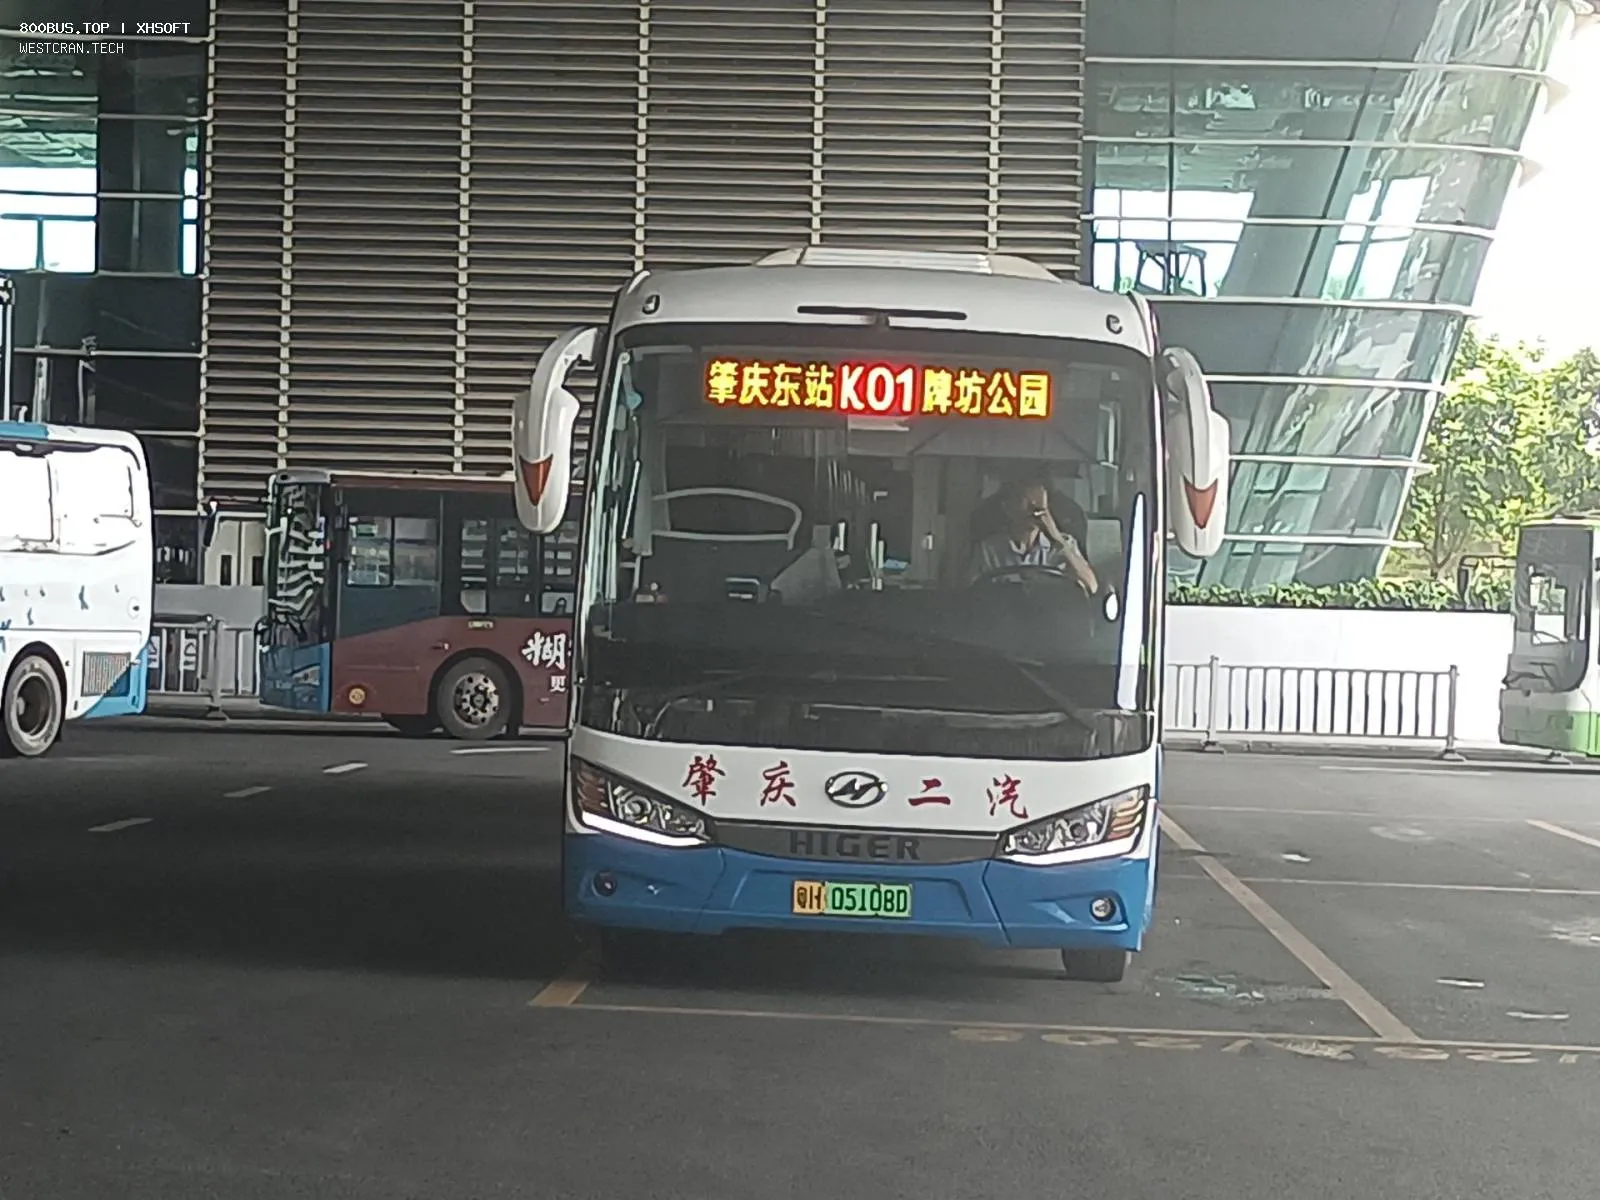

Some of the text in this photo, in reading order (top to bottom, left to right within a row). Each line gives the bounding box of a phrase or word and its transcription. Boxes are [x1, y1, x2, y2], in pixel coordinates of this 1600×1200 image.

[708, 360, 1049, 417] 肇庆东站 K01 牌坊公园
[789, 830, 921, 861] HIGER
